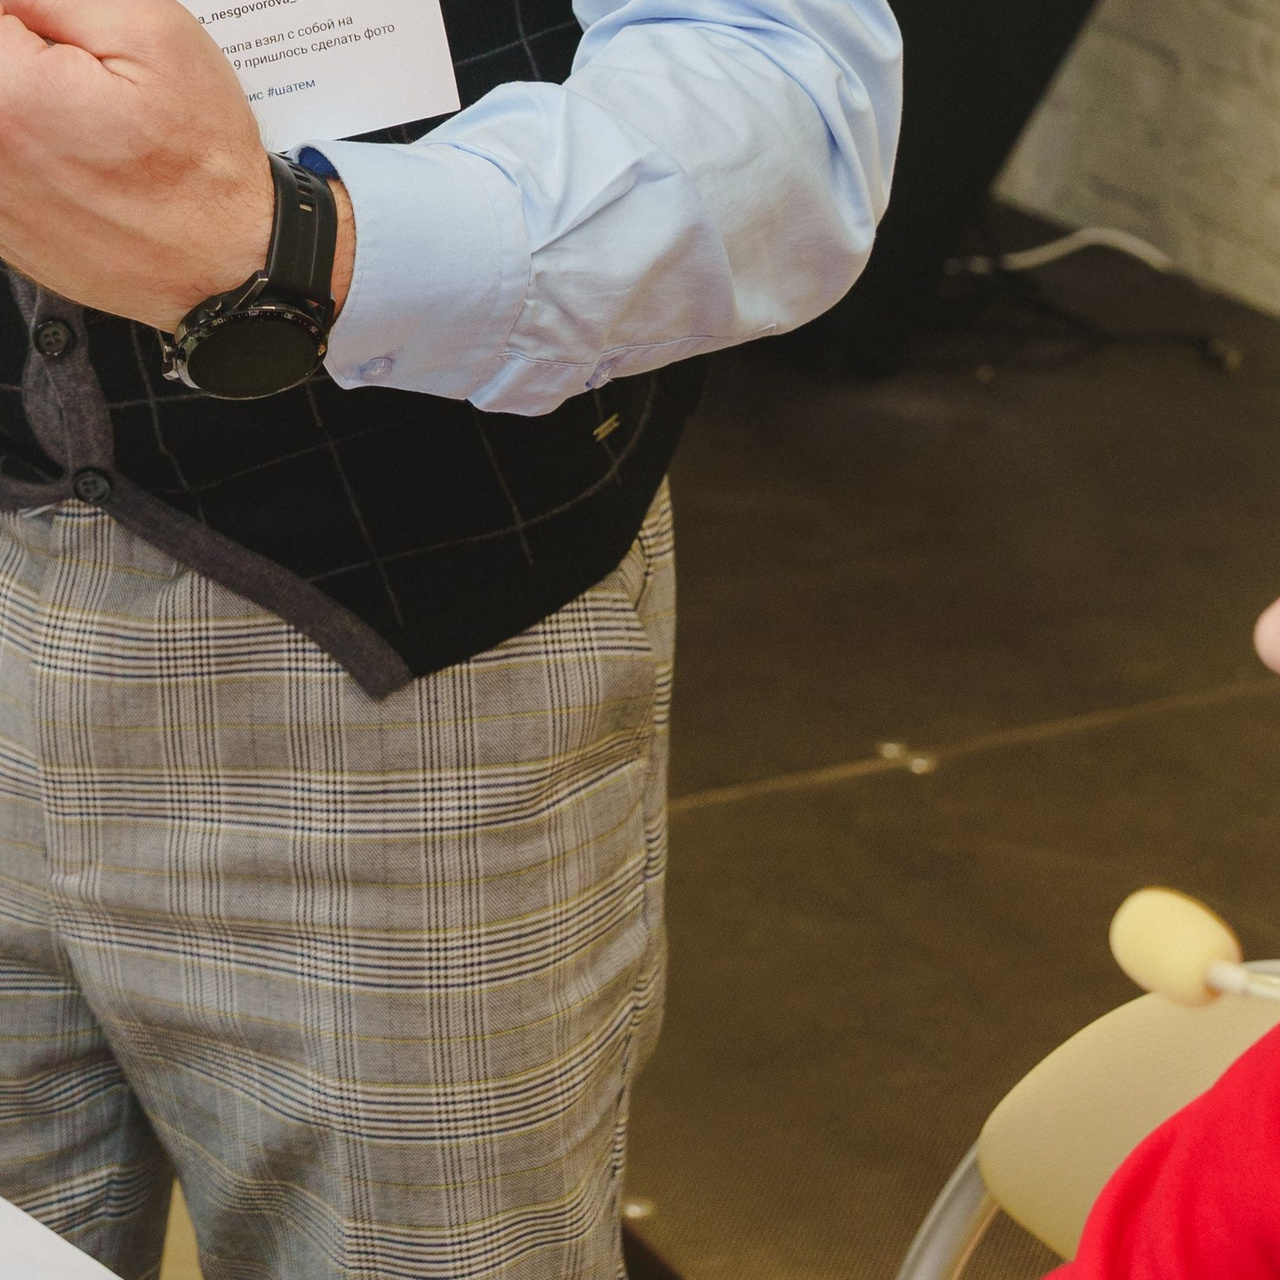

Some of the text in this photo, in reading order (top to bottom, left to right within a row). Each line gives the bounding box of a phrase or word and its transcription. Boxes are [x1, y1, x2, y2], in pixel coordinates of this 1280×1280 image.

[222, 16, 354, 55] папа взял с собой на
[233, 23, 396, 71] 9 пришлось сделать фото
[267, 79, 316, 98] #шатем
